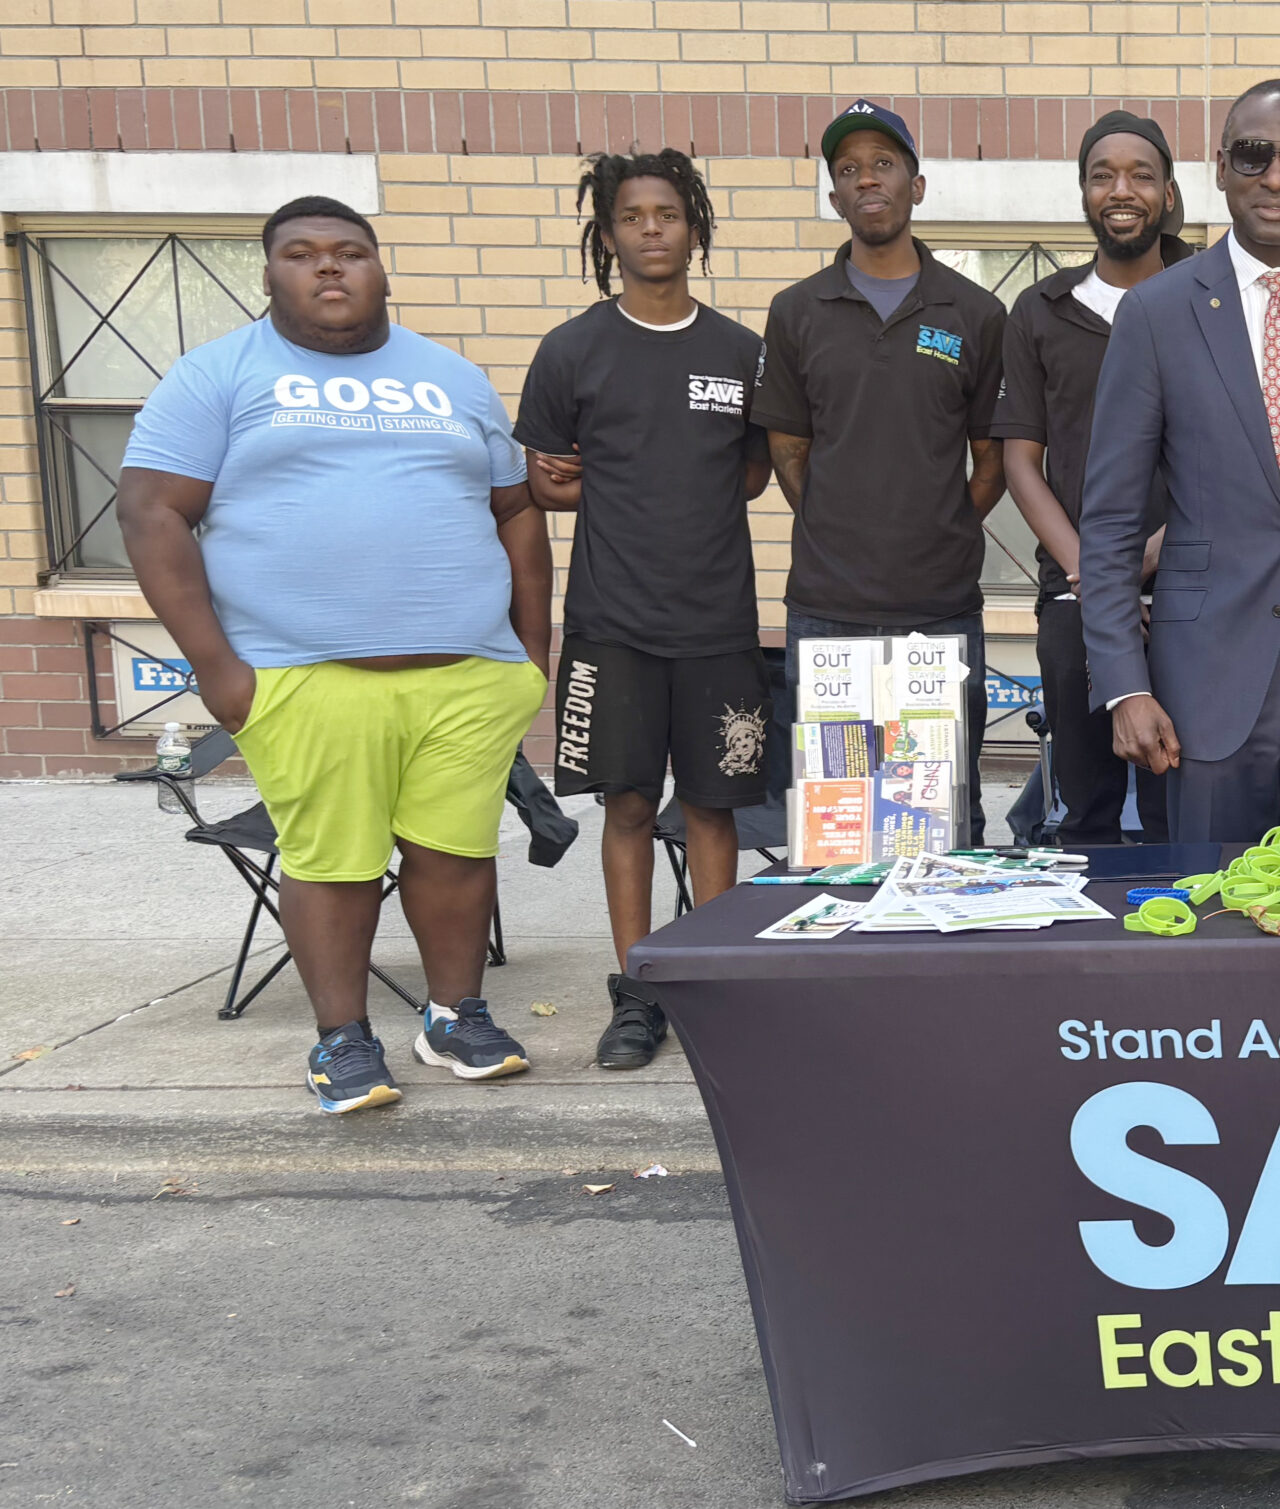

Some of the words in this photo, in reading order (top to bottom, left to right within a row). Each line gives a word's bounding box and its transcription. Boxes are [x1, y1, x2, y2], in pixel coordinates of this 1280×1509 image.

[917, 329, 962, 358] SAVE
[274, 374, 453, 417] GOSO
[688, 380, 744, 406] SAVE
[689, 400, 710, 411] East
[711, 403, 742, 415] Harlem
[277, 412, 337, 426] GETTING
[340, 416, 369, 428] OUT
[384, 418, 441, 431] STAYING
[443, 421, 466, 434] OUT
[813, 653, 851, 668] OUT
[908, 651, 945, 665] OUT
[814, 682, 852, 696] OUT
[908, 680, 946, 694] OUT
[558, 660, 598, 776] FREEDOM
[921, 762, 941, 800] GUNS
[1058, 1018, 1222, 1061] Stand
